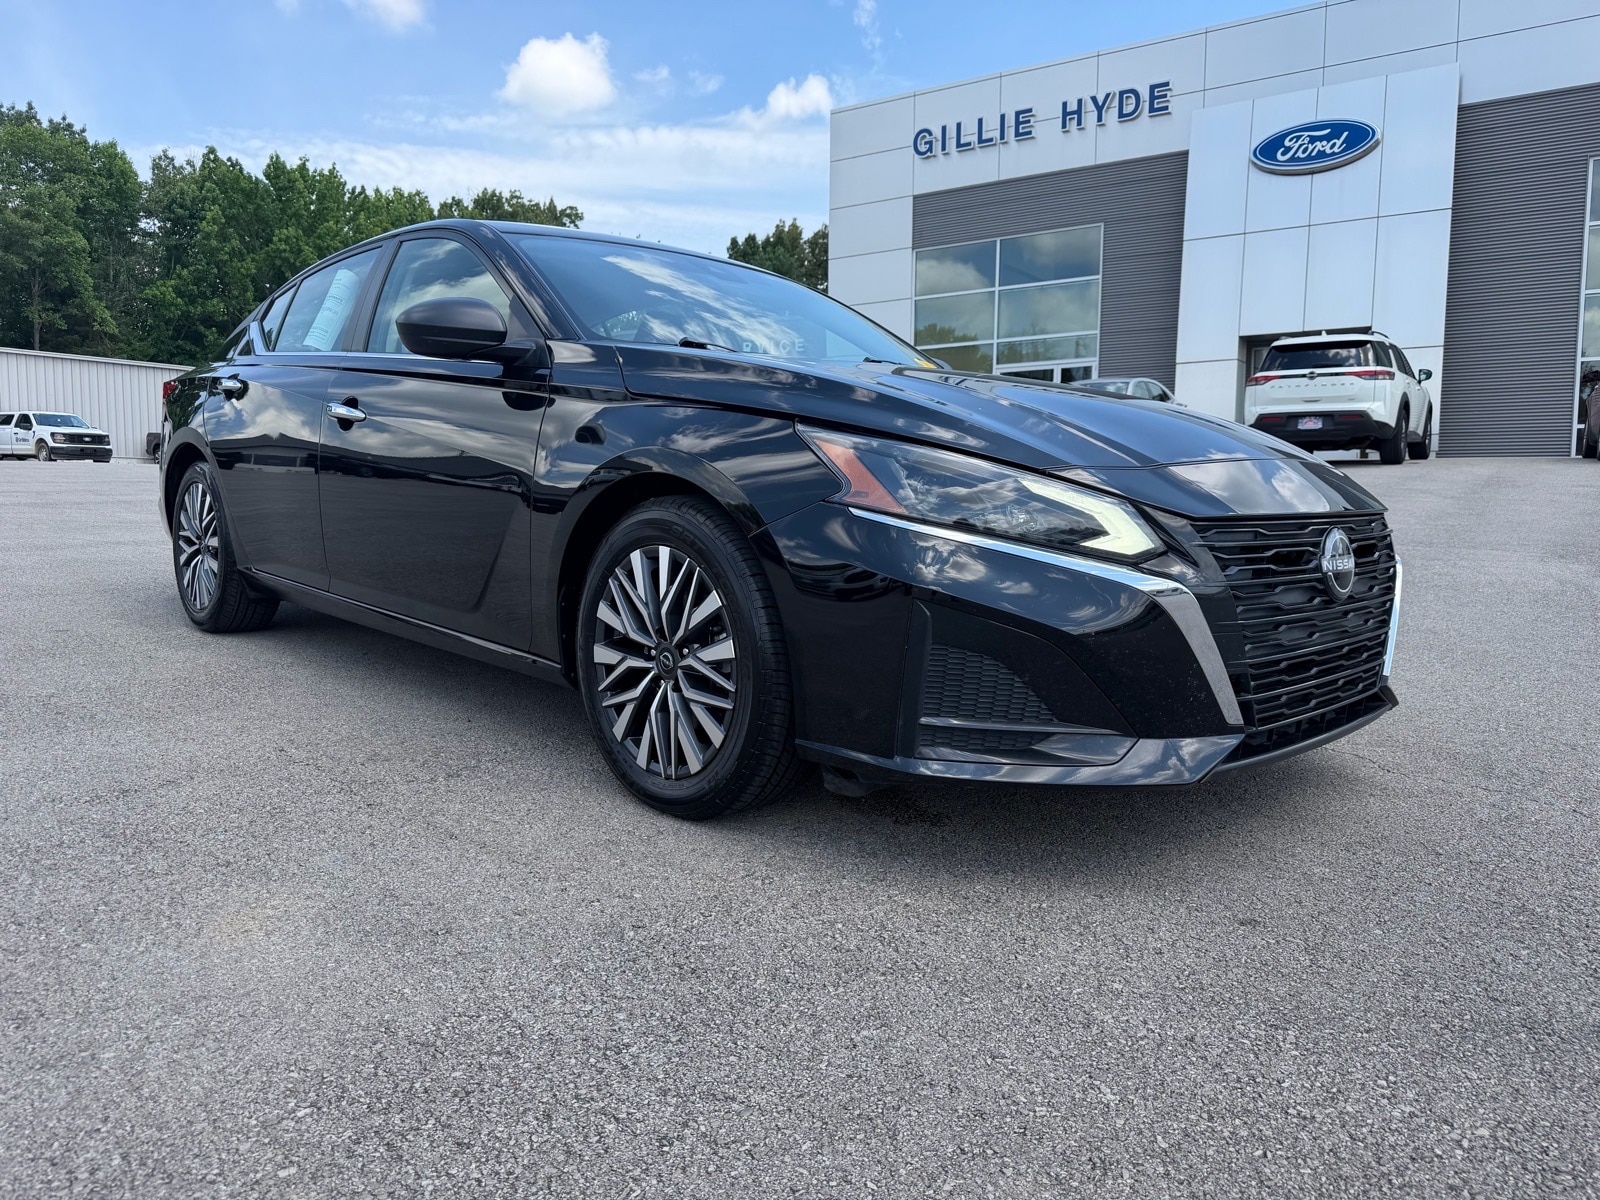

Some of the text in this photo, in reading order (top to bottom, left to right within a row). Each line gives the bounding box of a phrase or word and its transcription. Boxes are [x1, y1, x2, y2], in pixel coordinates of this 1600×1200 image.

[912, 80, 1171, 157] GILLIE HYDE
[1276, 128, 1349, 161] Ford
[1323, 559, 1353, 571] NISS
